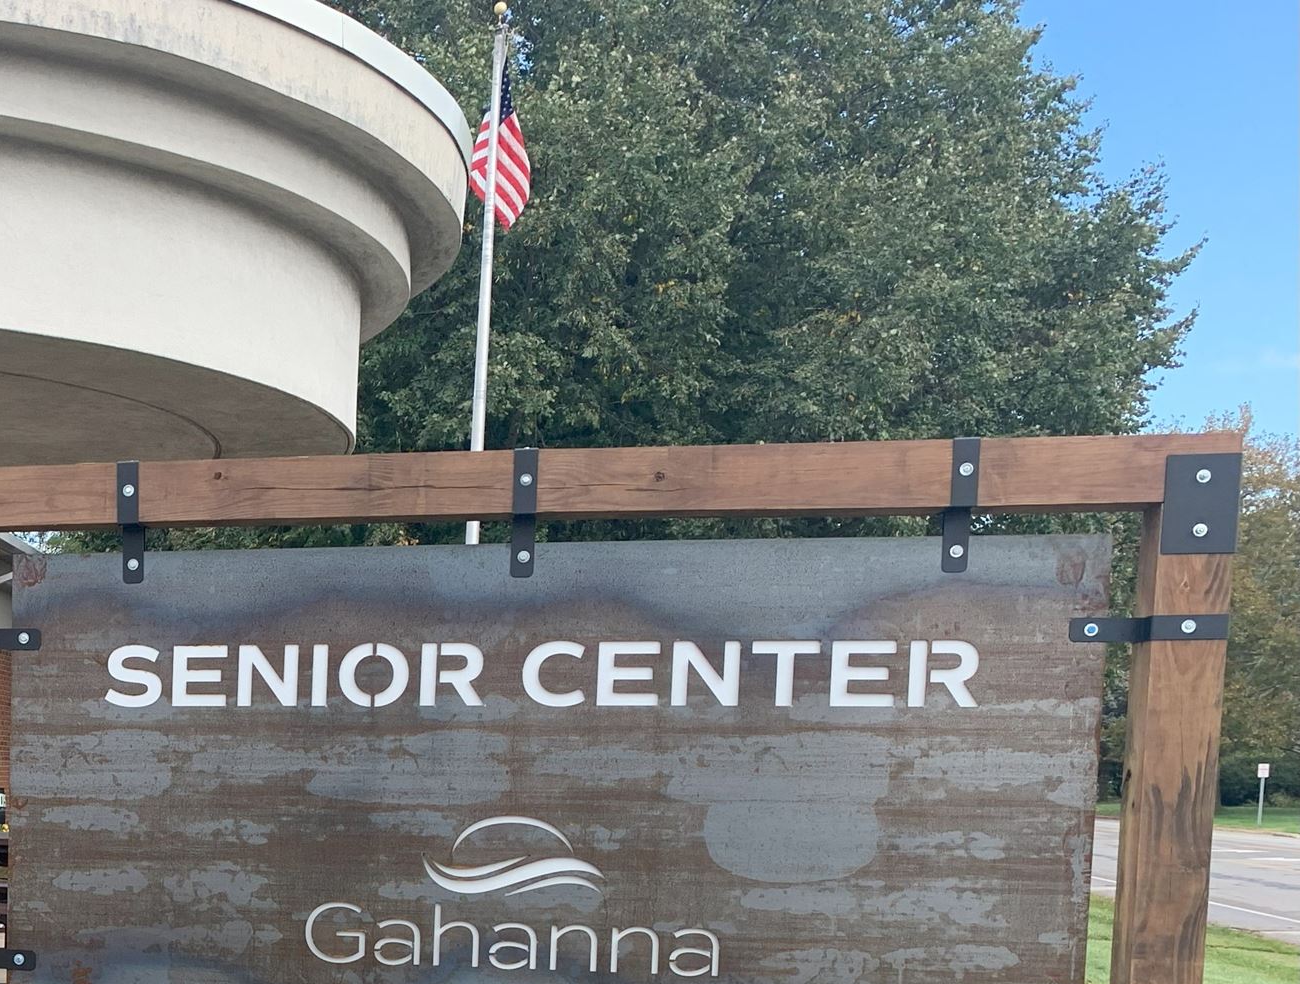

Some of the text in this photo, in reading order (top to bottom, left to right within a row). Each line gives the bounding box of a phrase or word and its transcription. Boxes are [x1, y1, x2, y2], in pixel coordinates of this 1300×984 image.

[104, 640, 979, 709] SENIOR CENTER
[305, 902, 720, 977] Gahanna
